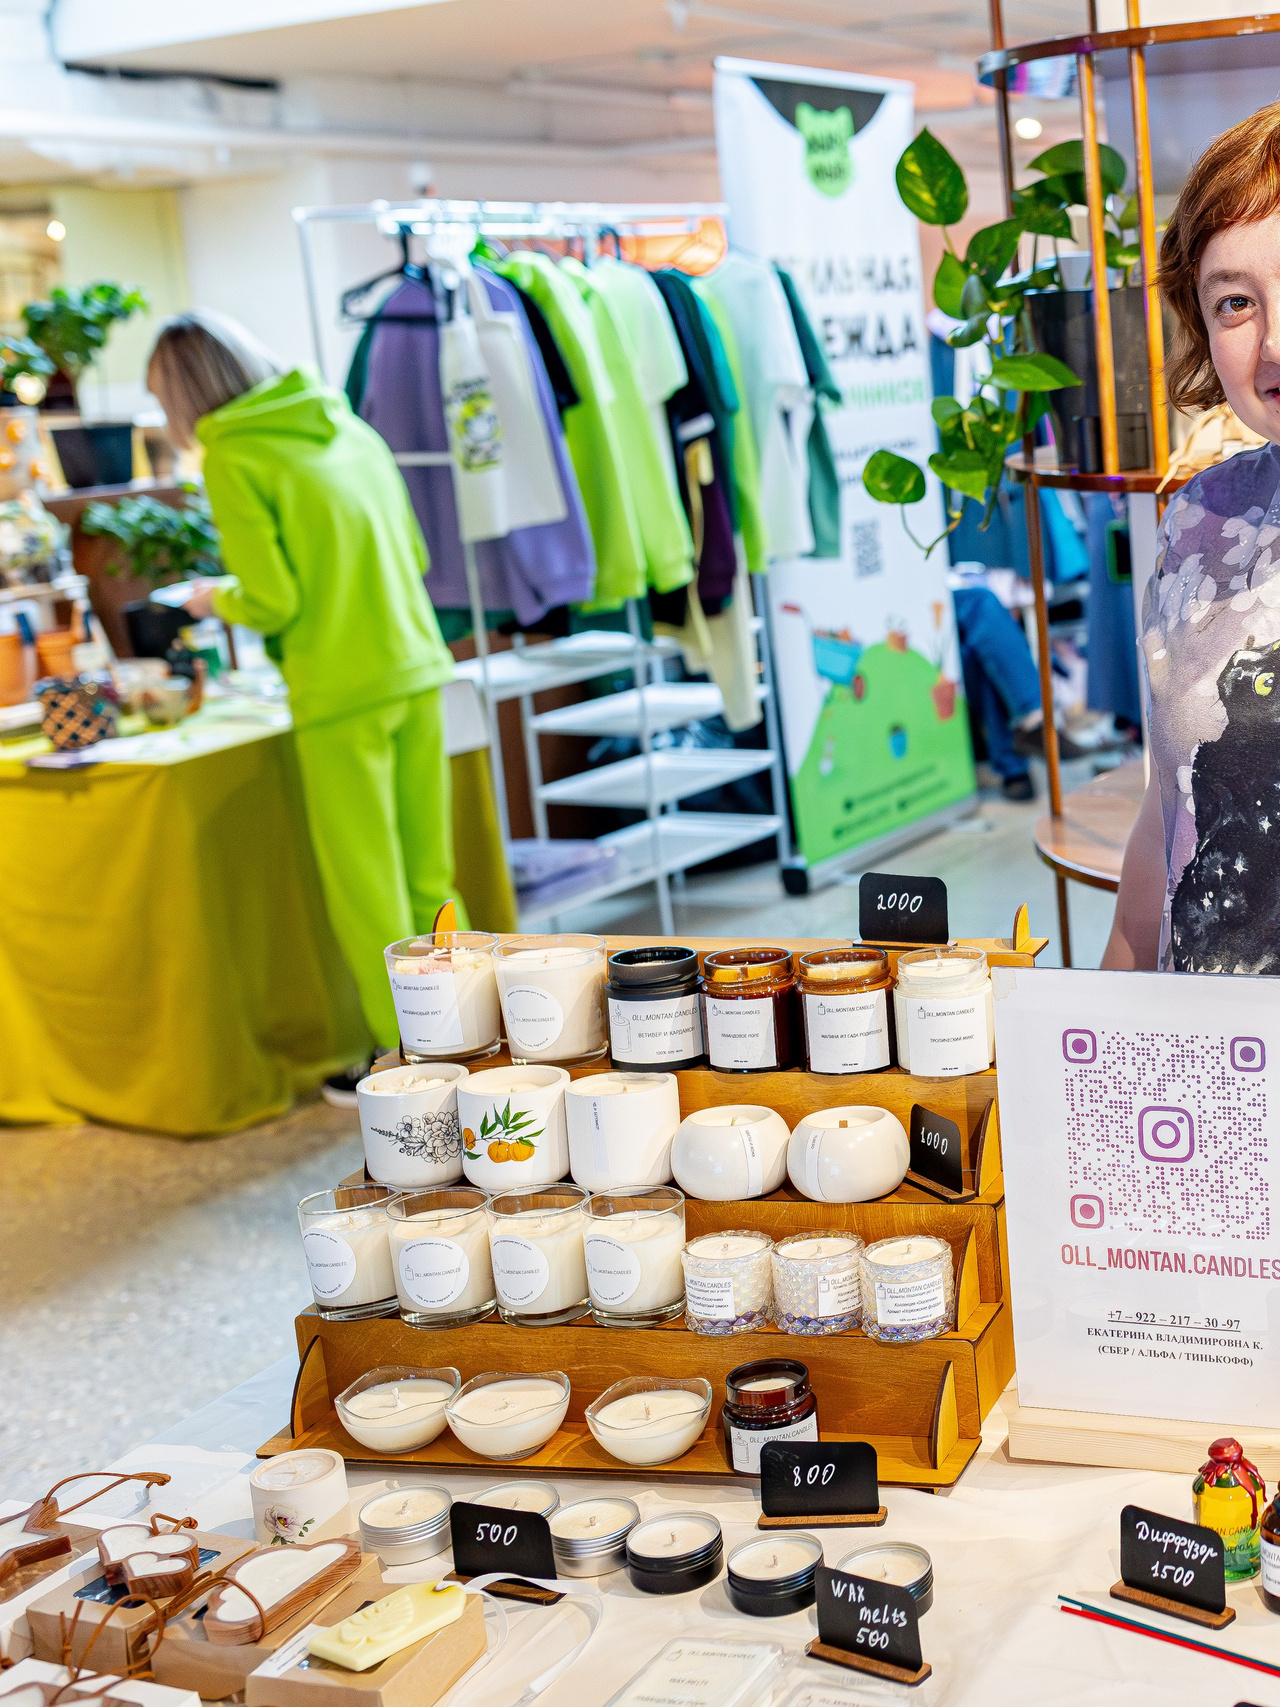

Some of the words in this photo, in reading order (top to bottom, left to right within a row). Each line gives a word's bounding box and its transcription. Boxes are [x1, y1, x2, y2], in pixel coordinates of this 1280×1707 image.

[823, 314, 918, 361] ЕЖДА
[876, 892, 923, 913] 2000
[632, 1007, 698, 1022] OLL_MONTAN.CANDLES
[930, 1036, 963, 1044] ТРОПИЧЕСКИЙ
[921, 1126, 949, 1155] 1000
[1135, 1311, 1156, 1324] 922
[1170, 1314, 1190, 1326] 217
[1204, 1317, 1218, 1329] 30
[1087, 1327, 1153, 1342] ЕКАТЕРИНА
[1156, 1333, 1250, 1349] ВЛАДИМИРОВНА
[1252, 1341, 1264, 1350] К.
[1098, 1345, 1130, 1356] (СБЕР
[1137, 1348, 1176, 1360] АЛЬФА
[1184, 1352, 1254, 1368] ТИНЬКОФФ)
[793, 1463, 836, 1487] 800
[475, 1521, 519, 1547] 500
[1151, 1560, 1195, 1587] 1500
[859, 1604, 908, 1627] melts
[856, 1627, 890, 1650] 500
